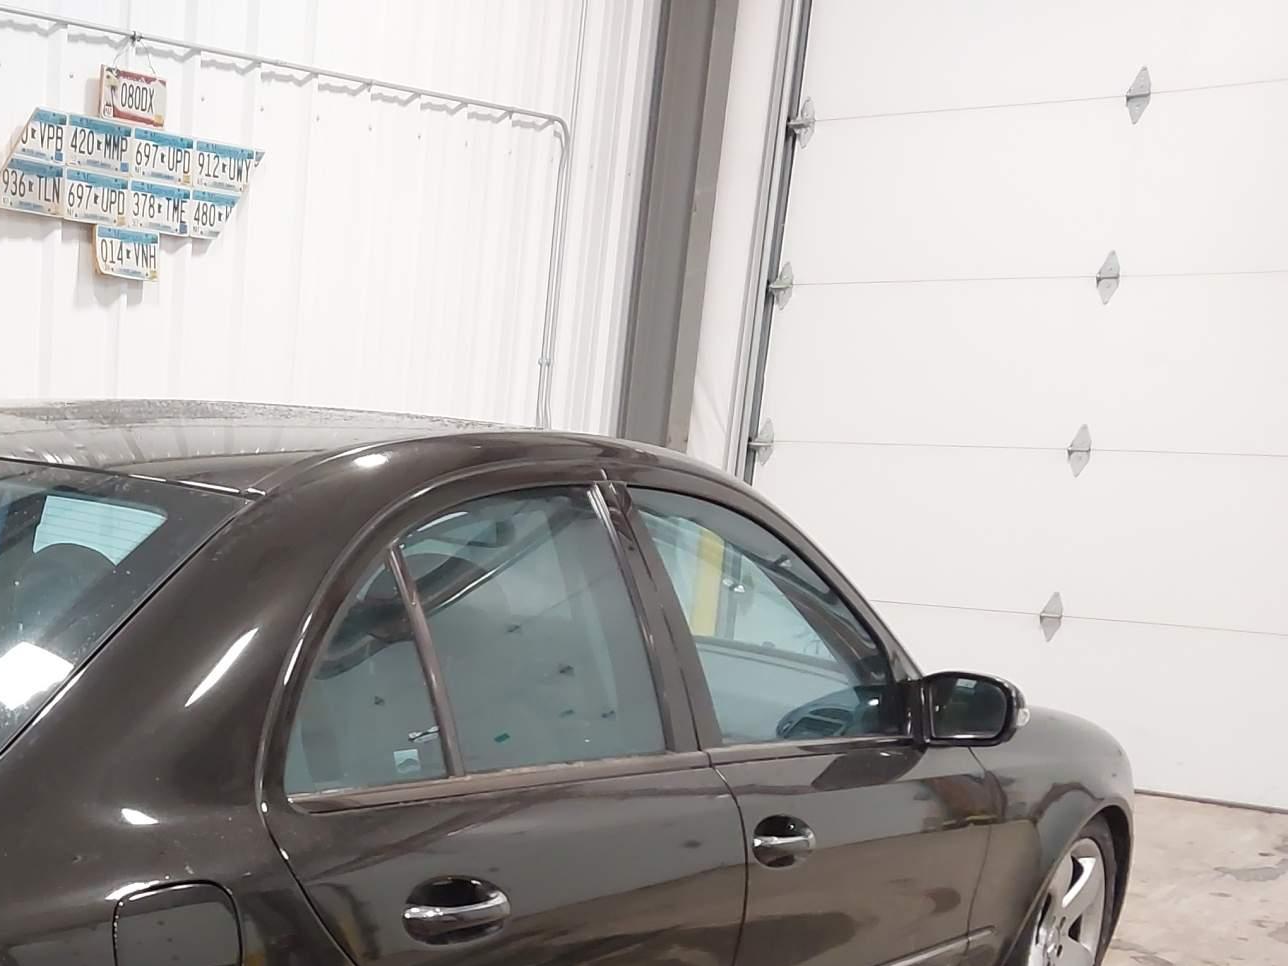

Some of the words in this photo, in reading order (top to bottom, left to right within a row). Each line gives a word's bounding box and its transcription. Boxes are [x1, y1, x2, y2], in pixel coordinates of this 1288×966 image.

[70, 127, 95, 156] 420
[135, 141, 159, 168] 697
[198, 152, 220, 178] 912
[2, 168, 26, 198] 936
[67, 183, 92, 210] 697
[132, 192, 156, 218] 378
[193, 202, 216, 227] 480
